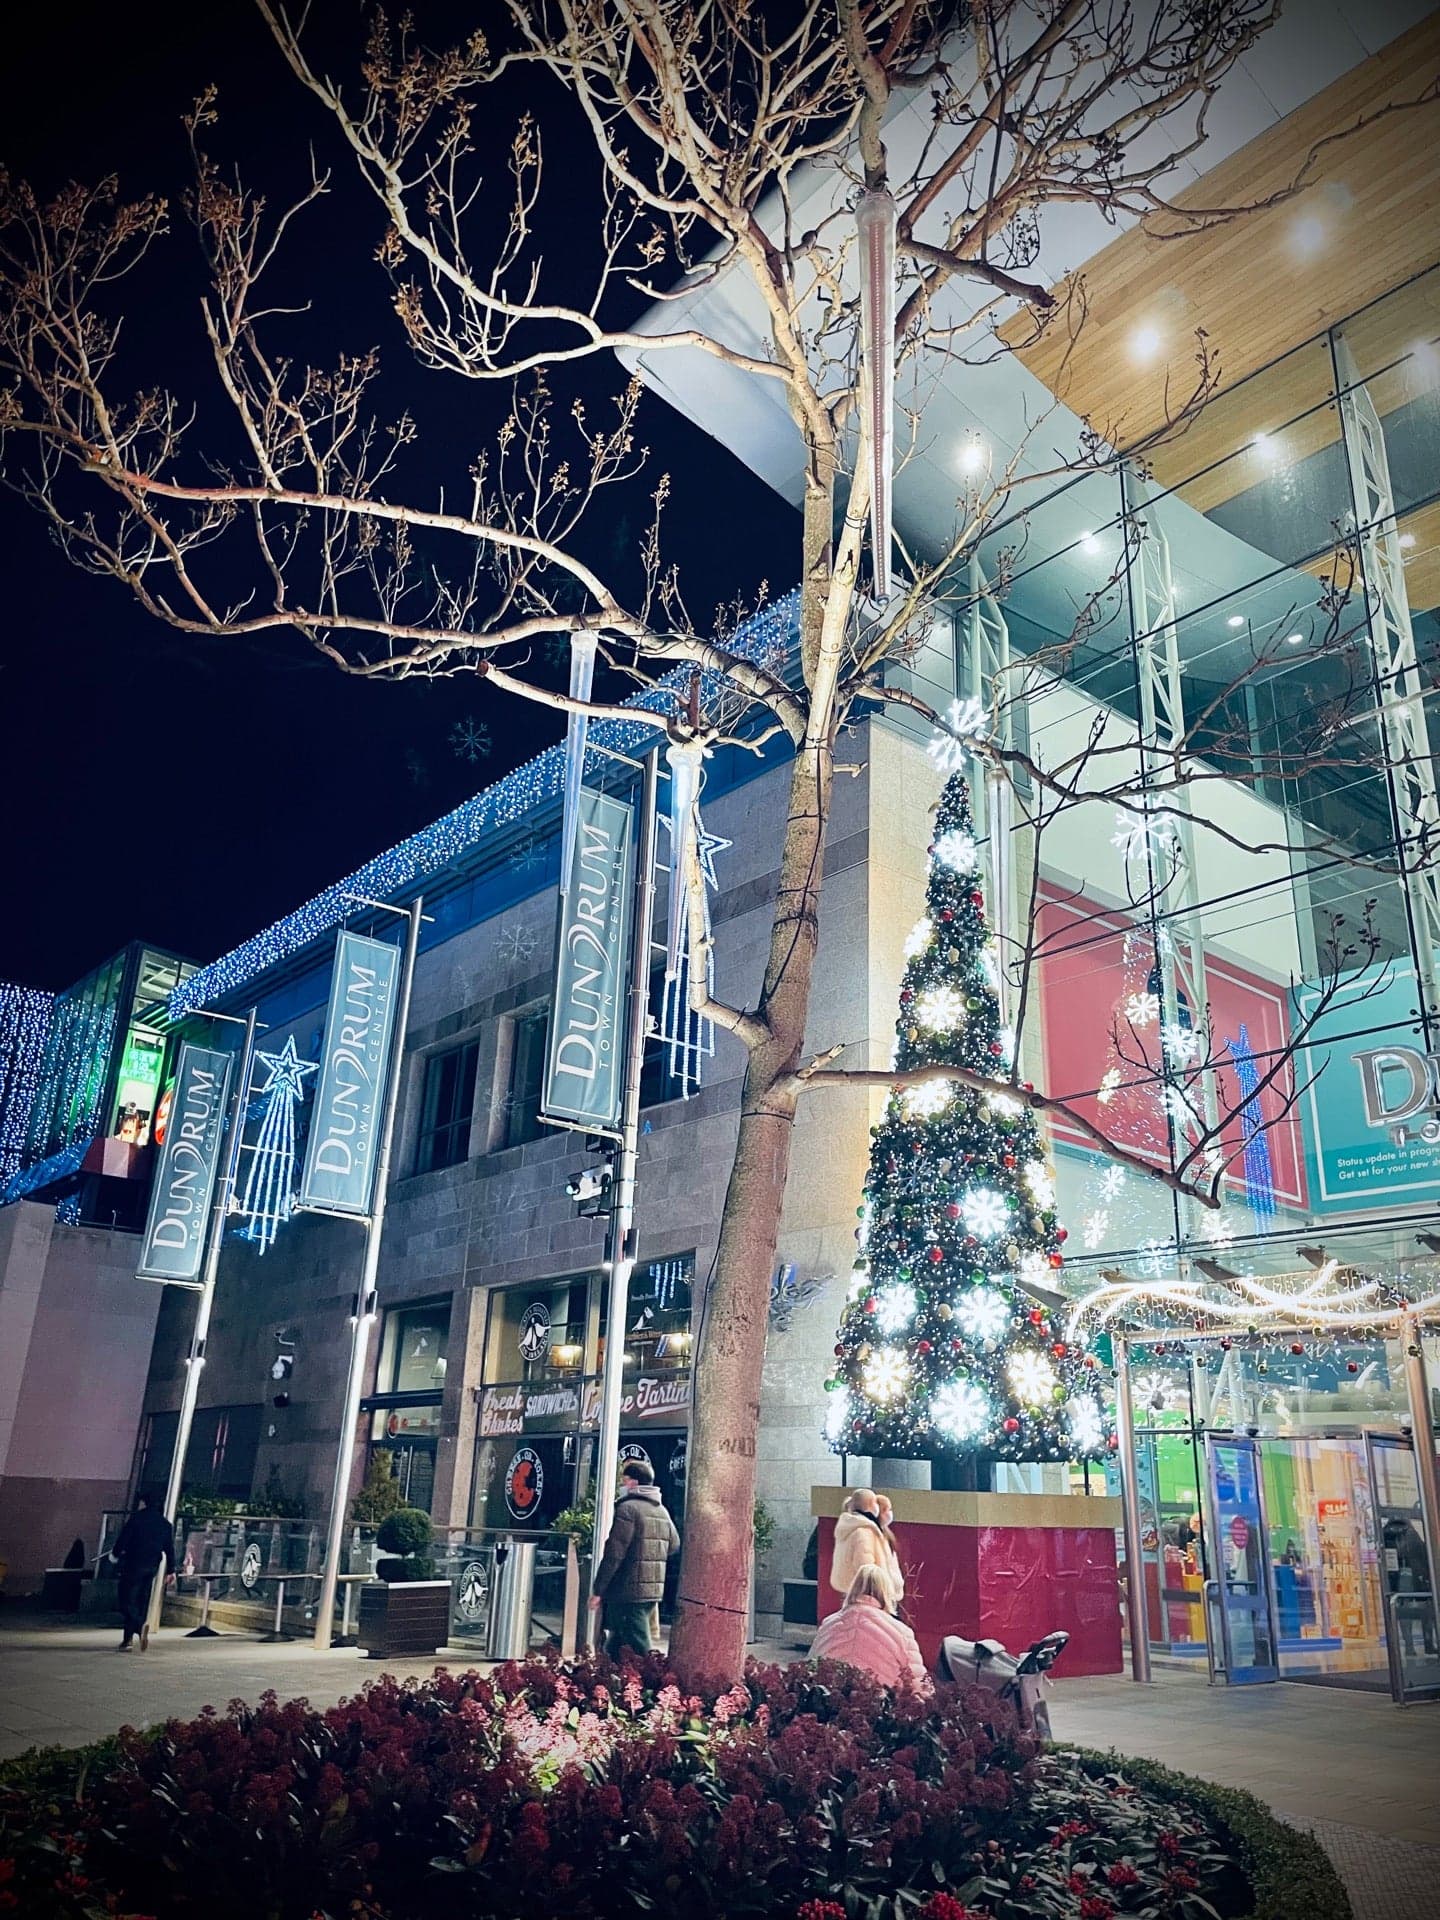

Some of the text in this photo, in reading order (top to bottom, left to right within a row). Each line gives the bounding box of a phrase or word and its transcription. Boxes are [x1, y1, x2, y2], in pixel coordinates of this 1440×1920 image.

[555, 820, 613, 1079] DUNDRUM
[600, 845, 623, 1068] TOWN CENTRE
[152, 1066, 215, 1249] DUNDRUM
[315, 962, 377, 1175] DUNDRUM
[355, 980, 388, 1168] TOWN CENTRE
[1337, 1157, 1363, 1168] Status
[1366, 1152, 1396, 1164] update
[1398, 1150, 1407, 1159] in
[1351, 1045, 1440, 1128] D
[189, 1187, 206, 1240] TOWN
[1338, 1170, 1354, 1180] Get
[1358, 1169, 1369, 1178] set
[1372, 1165, 1385, 1175] for
[1387, 1164, 1407, 1176] your
[1410, 1161, 1429, 1170] new
